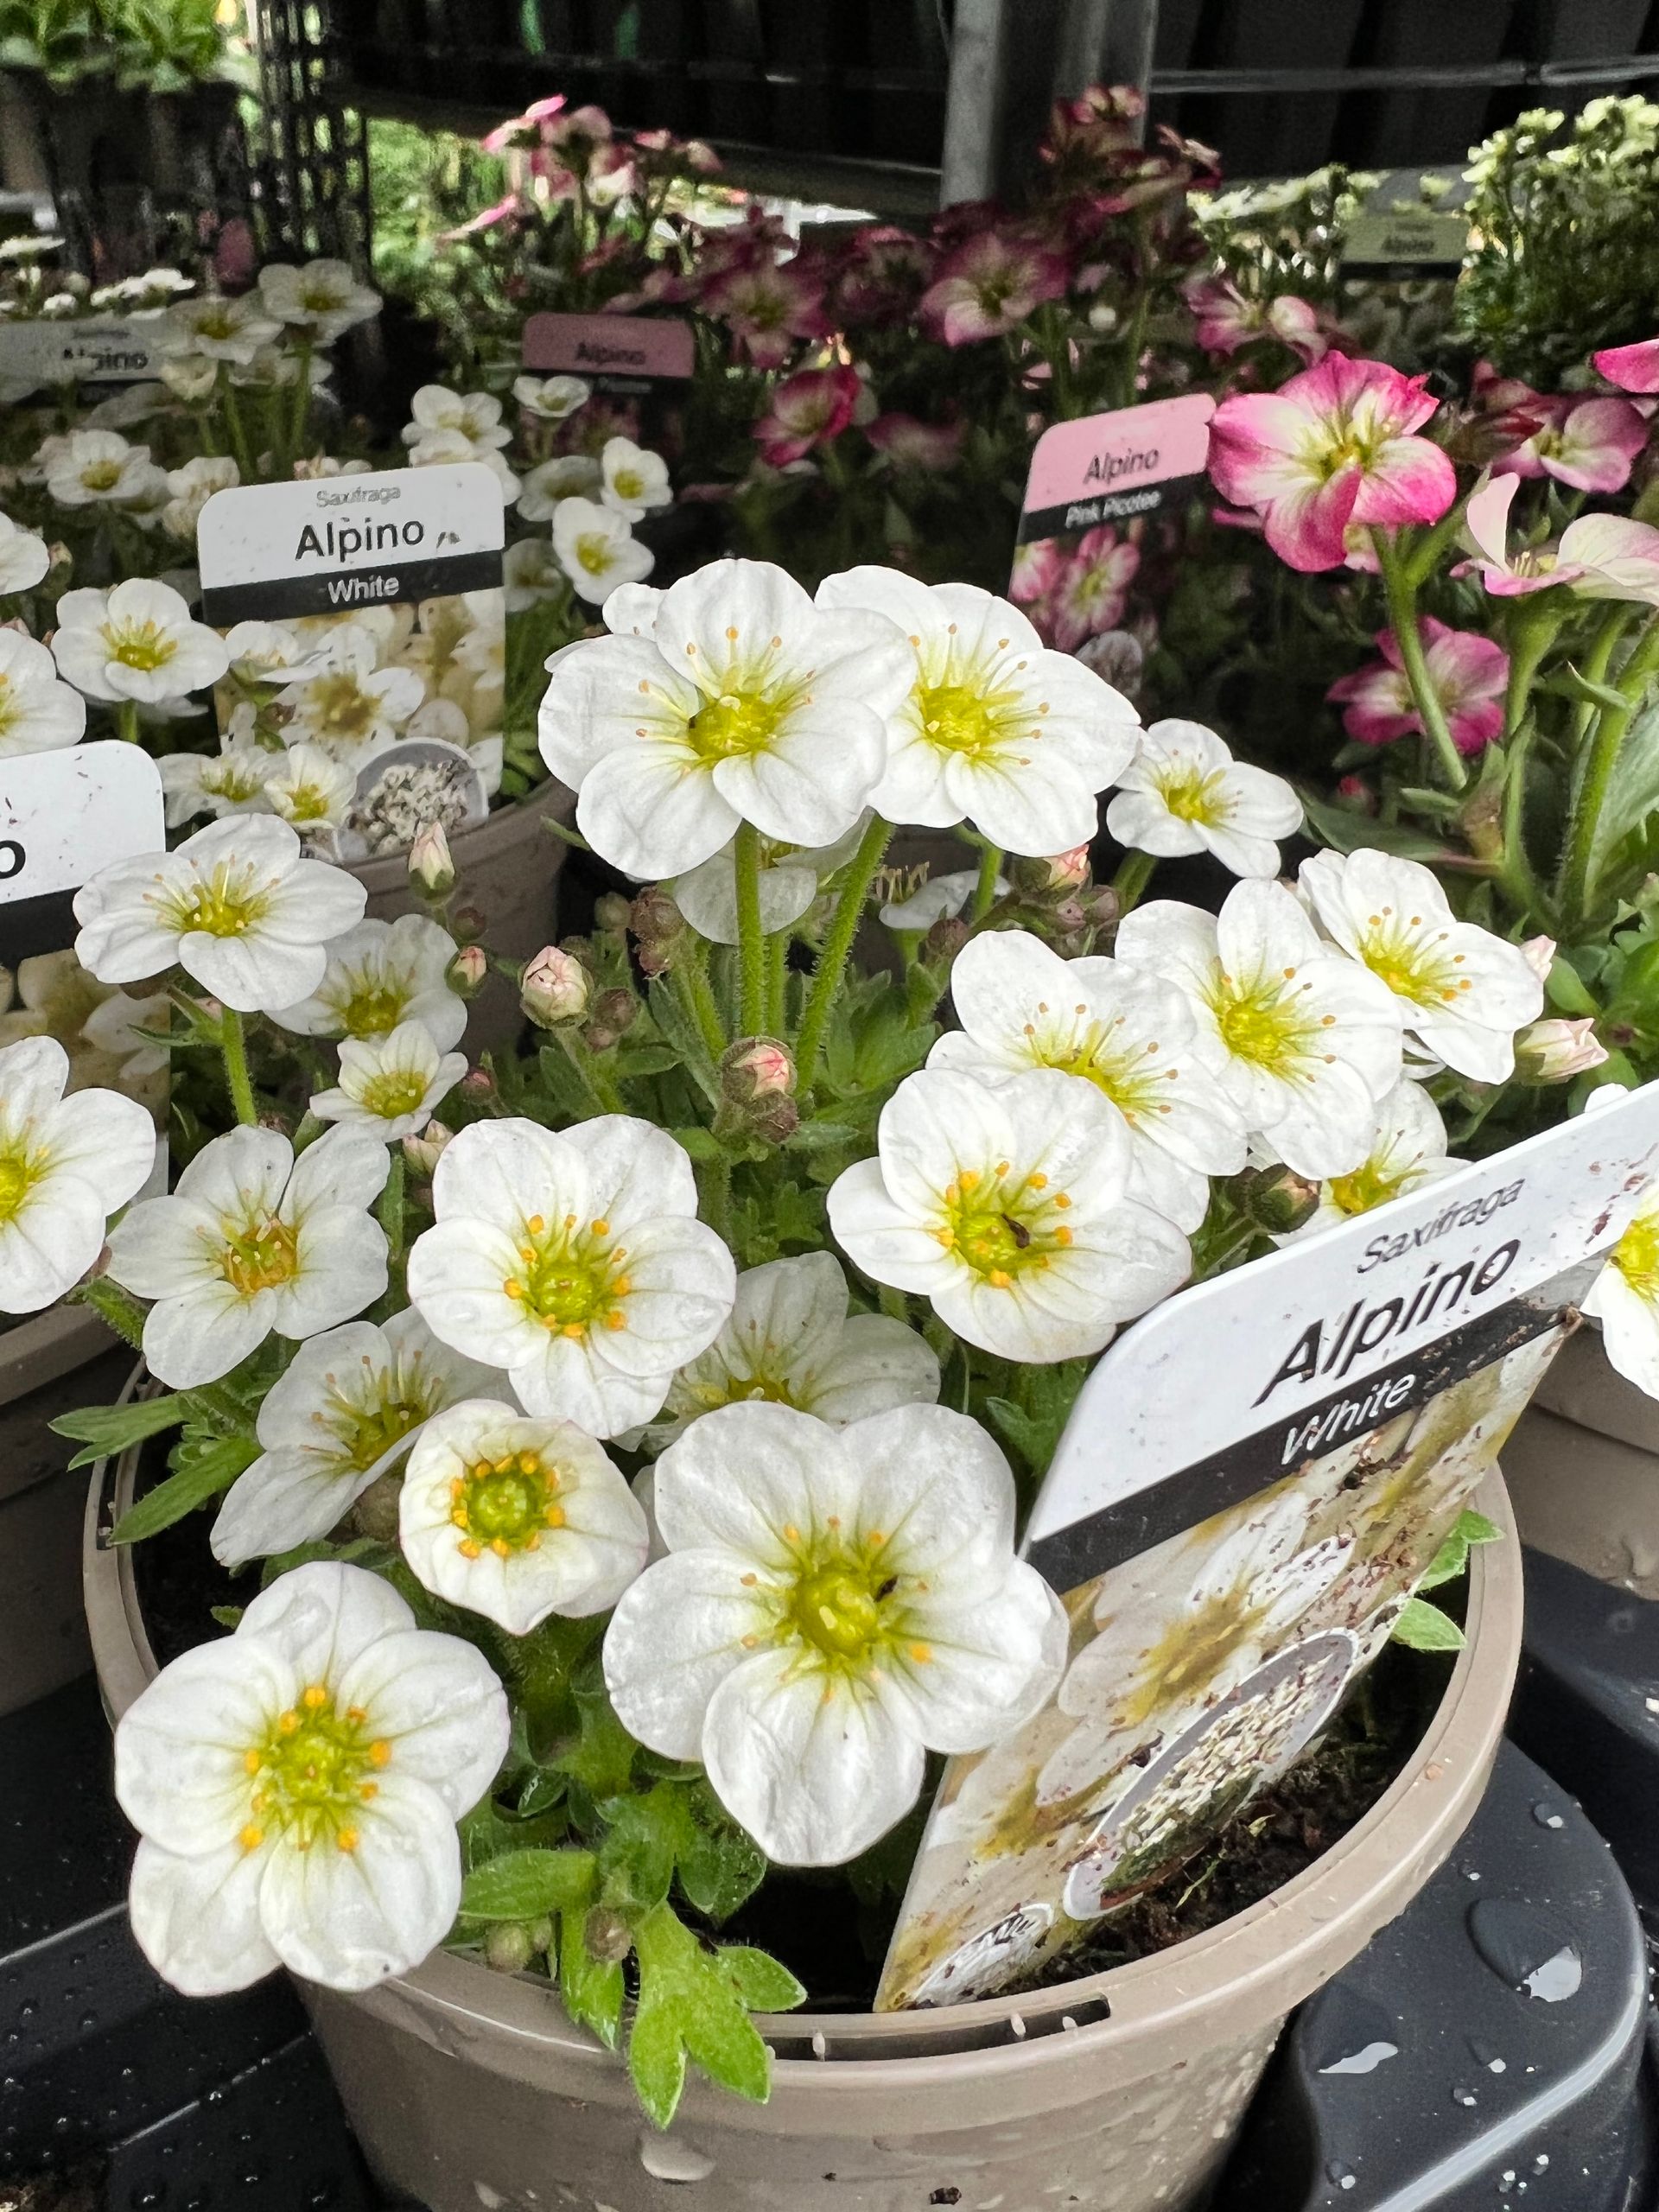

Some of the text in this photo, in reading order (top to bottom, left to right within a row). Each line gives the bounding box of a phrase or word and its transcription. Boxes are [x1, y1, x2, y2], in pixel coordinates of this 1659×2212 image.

[1083, 448, 1160, 486] Alpino
[295, 517, 424, 563] Alpino
[327, 575, 399, 604] White
[1357, 1178, 1526, 1274] Saxifraga
[1250, 1238, 1522, 1409] Alpino
[1281, 1374, 1416, 1465] White
